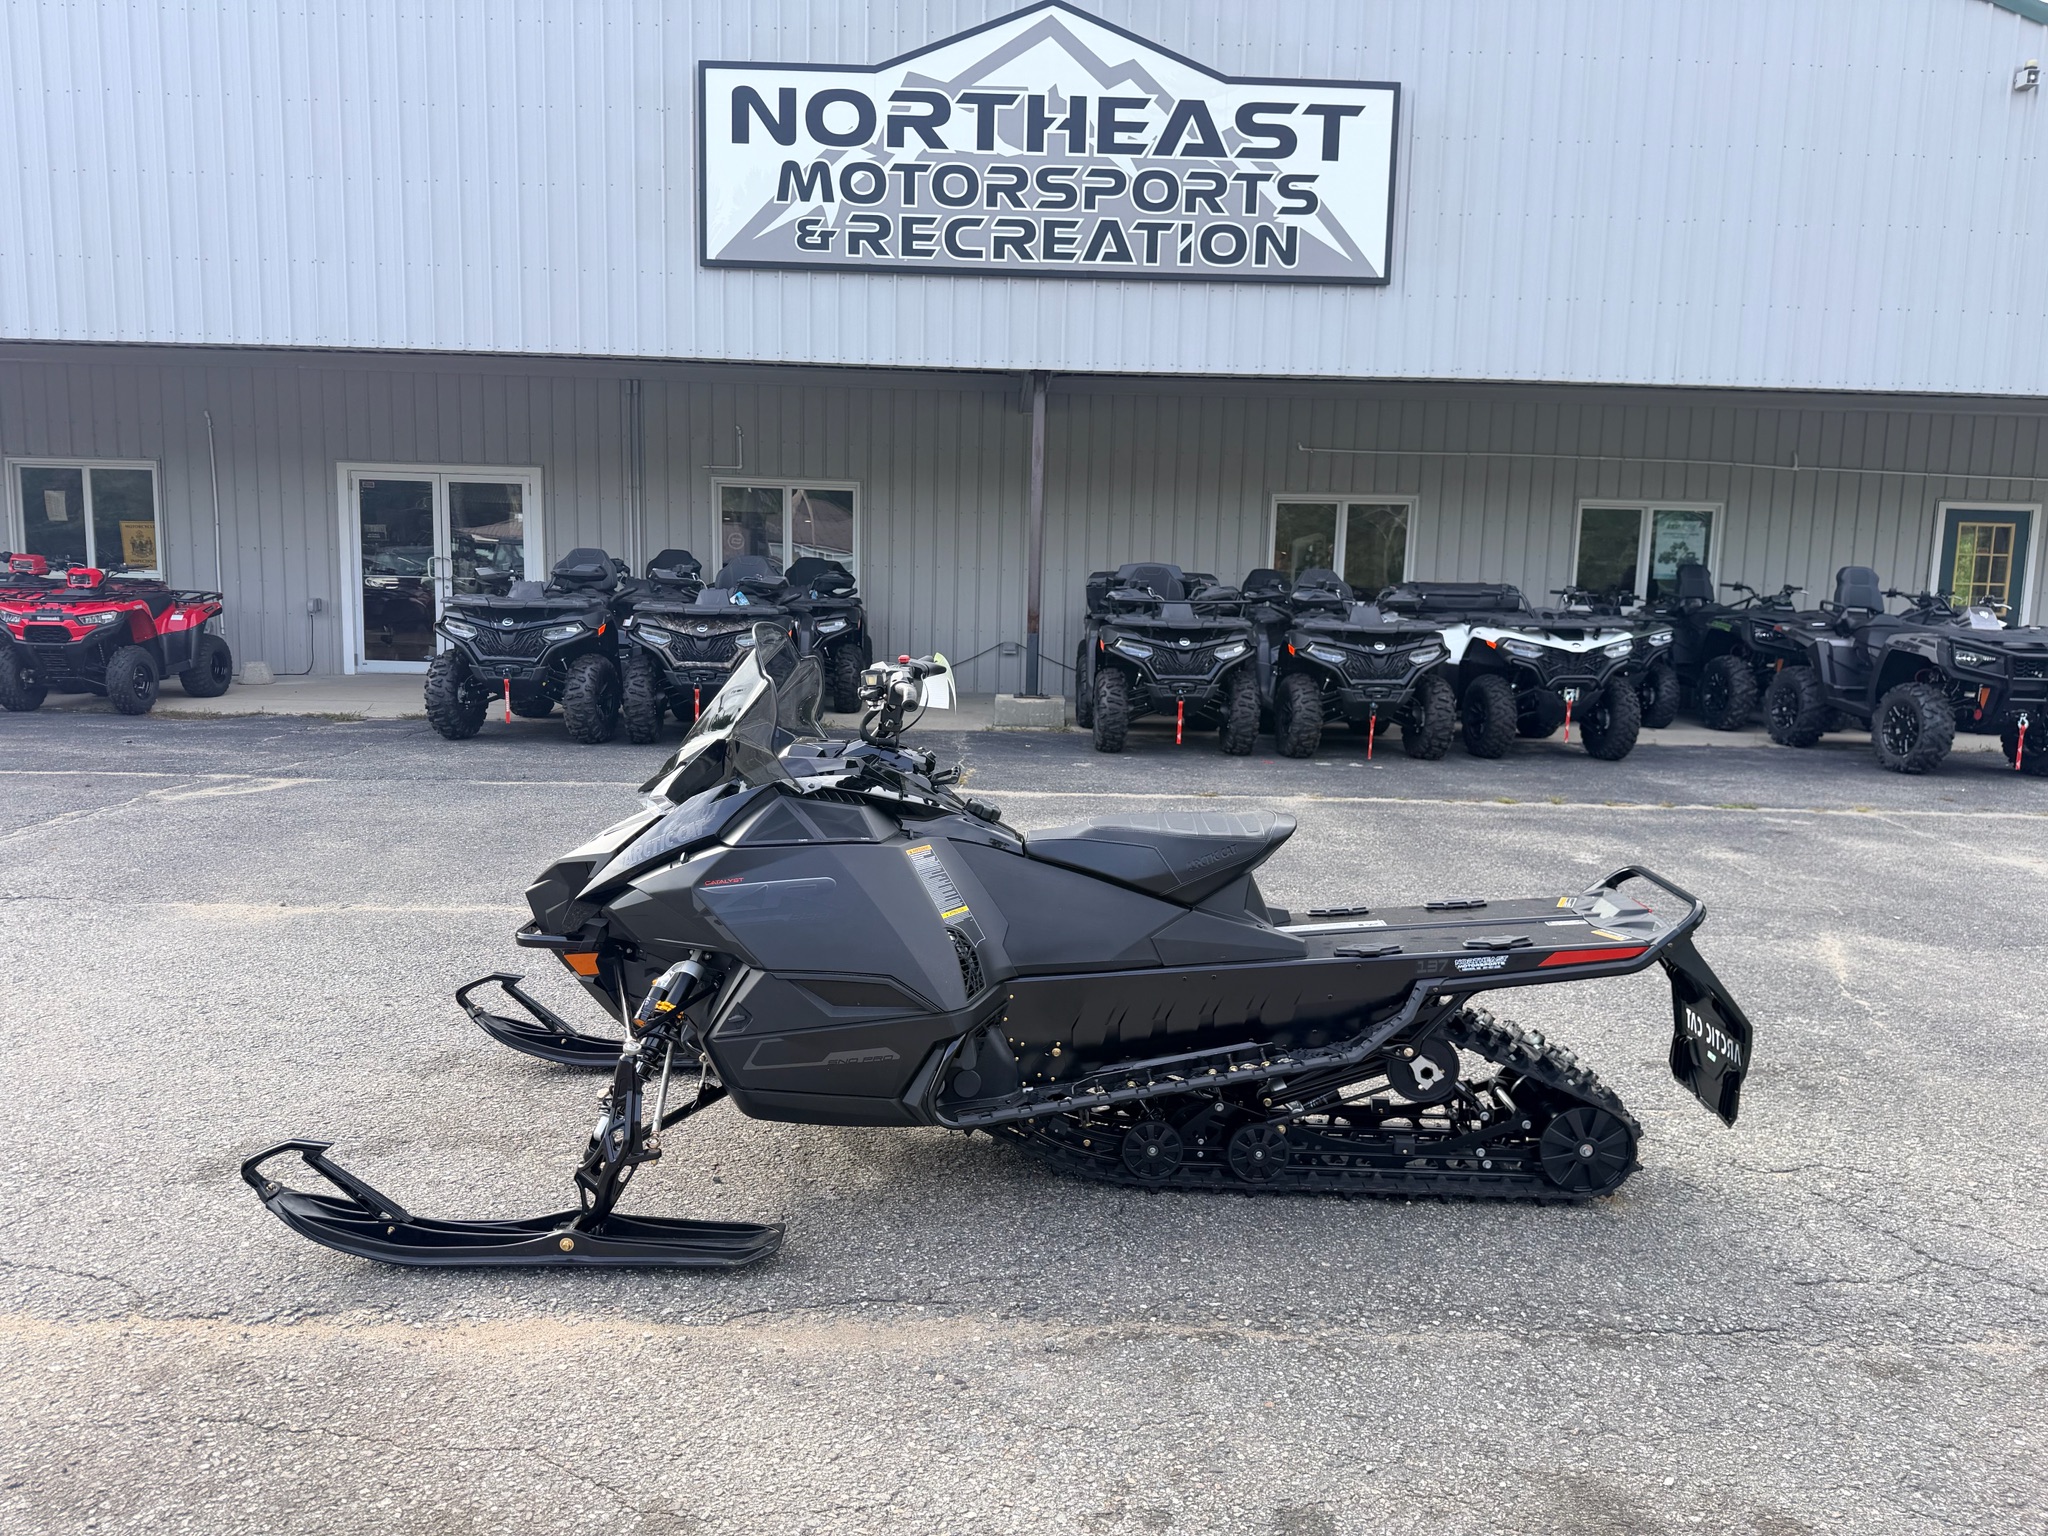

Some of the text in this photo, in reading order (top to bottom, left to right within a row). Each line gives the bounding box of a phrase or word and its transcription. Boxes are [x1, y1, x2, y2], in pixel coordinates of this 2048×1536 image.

[731, 85, 1367, 161] NORTHEAST
[775, 160, 1320, 216] MOTORSPORTS
[623, 817, 706, 866] ARCTIC CAT
[704, 877, 745, 886] CATALYST
[1416, 959, 1449, 974] 137
